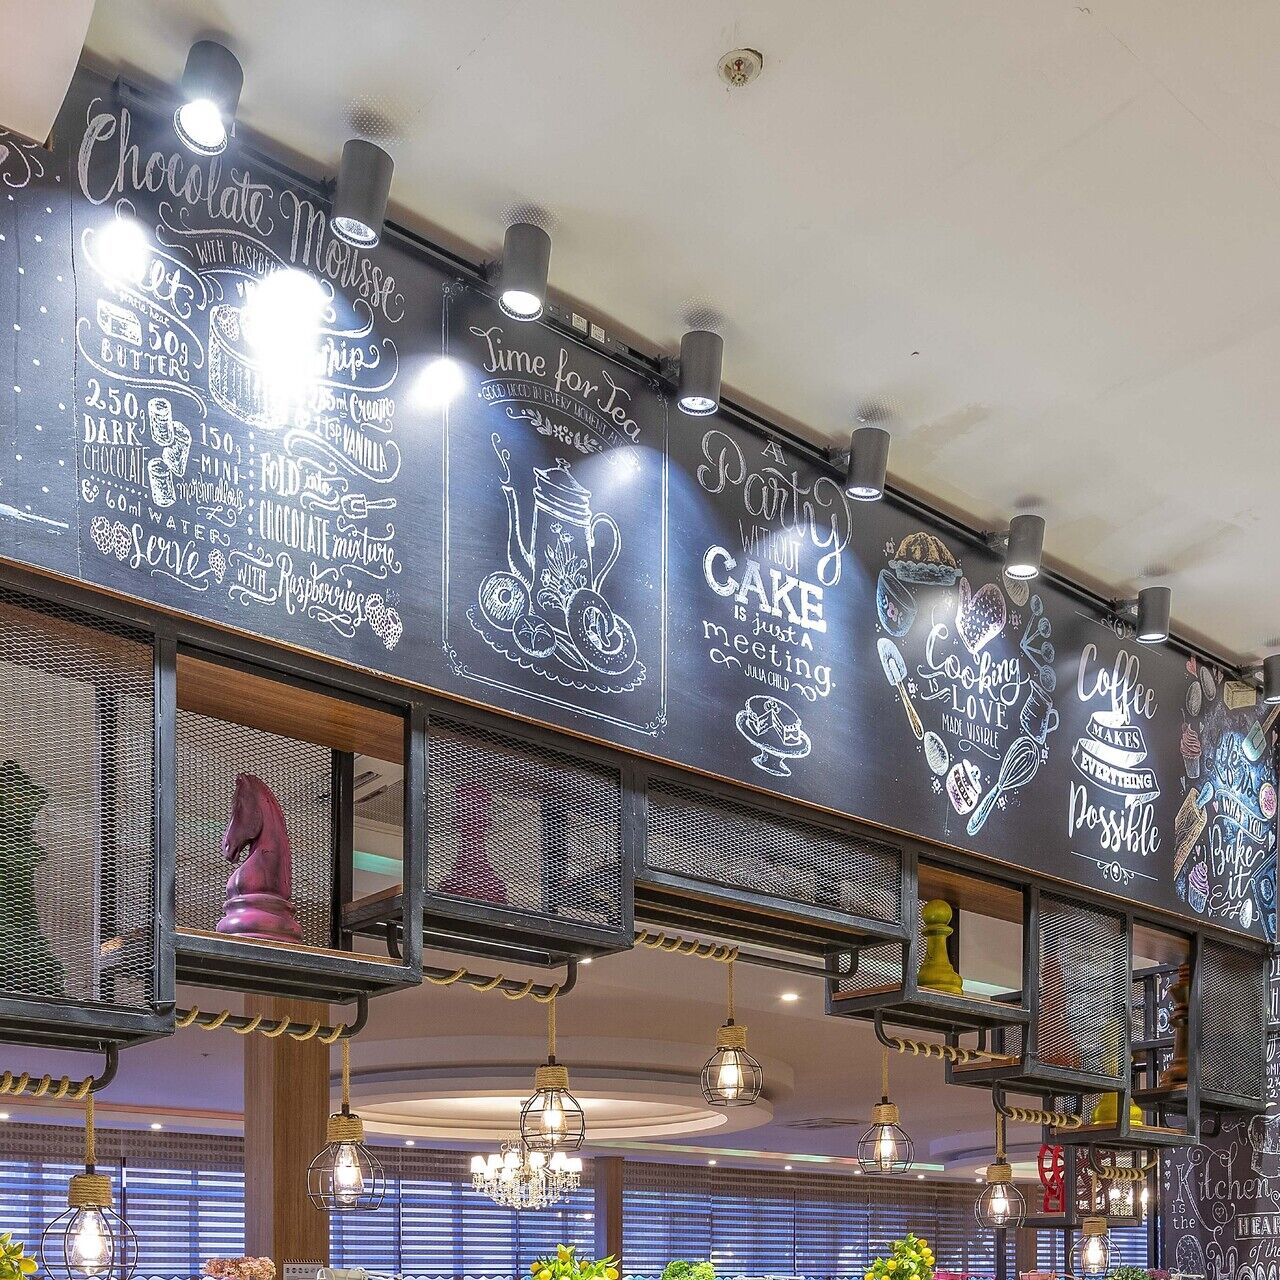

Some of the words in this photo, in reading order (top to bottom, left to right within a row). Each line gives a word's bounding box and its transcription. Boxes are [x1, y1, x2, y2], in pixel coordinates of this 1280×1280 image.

[77, 97, 275, 237] Chocolate
[278, 189, 405, 323] Mousse
[195, 239, 227, 266] WITH
[100, 337, 190, 382] BUTTER
[148, 322, 189, 367] 50g
[318, 336, 381, 381] hip
[469, 325, 547, 377] Time
[554, 347, 600, 399] for
[596, 369, 642, 444] Tea
[82, 412, 143, 447] DARK
[481, 383, 506, 401] GOOD
[543, 390, 572, 411] EVERY
[573, 403, 607, 436] MOMENT
[83, 444, 151, 489] CHOCOLATE
[343, 423, 388, 473] VANILLA
[760, 439, 788, 467] A
[303, 468, 349, 496] into
[147, 506, 231, 547] WATER
[695, 429, 854, 588] Party
[259, 499, 331, 561] CHOCOLATE
[331, 525, 402, 574] mixture
[738, 517, 804, 575] WITHOUT
[276, 551, 368, 627] Raspberries
[701, 543, 828, 635] CAKE
[733, 603, 748, 623] IS
[751, 611, 799, 648] just
[800, 631, 814, 652] A
[701, 618, 837, 698] meeting.
[744, 662, 768, 686] JULIA
[767, 670, 791, 692] CHILD
[925, 610, 1030, 704] Cooking
[928, 676, 940, 695] IS
[949, 683, 1010, 731] LOVE
[1076, 642, 1159, 727] Coffee
[941, 710, 963, 738] MADE
[965, 721, 1000, 750] VISIBLE
[1090, 721, 1141, 750] MAKES
[1079, 755, 1153, 791] EVERYTHING
[1067, 779, 1162, 857] Possible
[1221, 796, 1245, 825] WHAT
[1247, 813, 1263, 839] YOU
[1208, 823, 1265, 878] Bake
[1223, 866, 1255, 901] it
[1176, 1146, 1272, 1204] Kitchen
[1171, 1199, 1186, 1214] is
[1172, 1215, 1196, 1230] the
[1249, 1239, 1265, 1266] of
